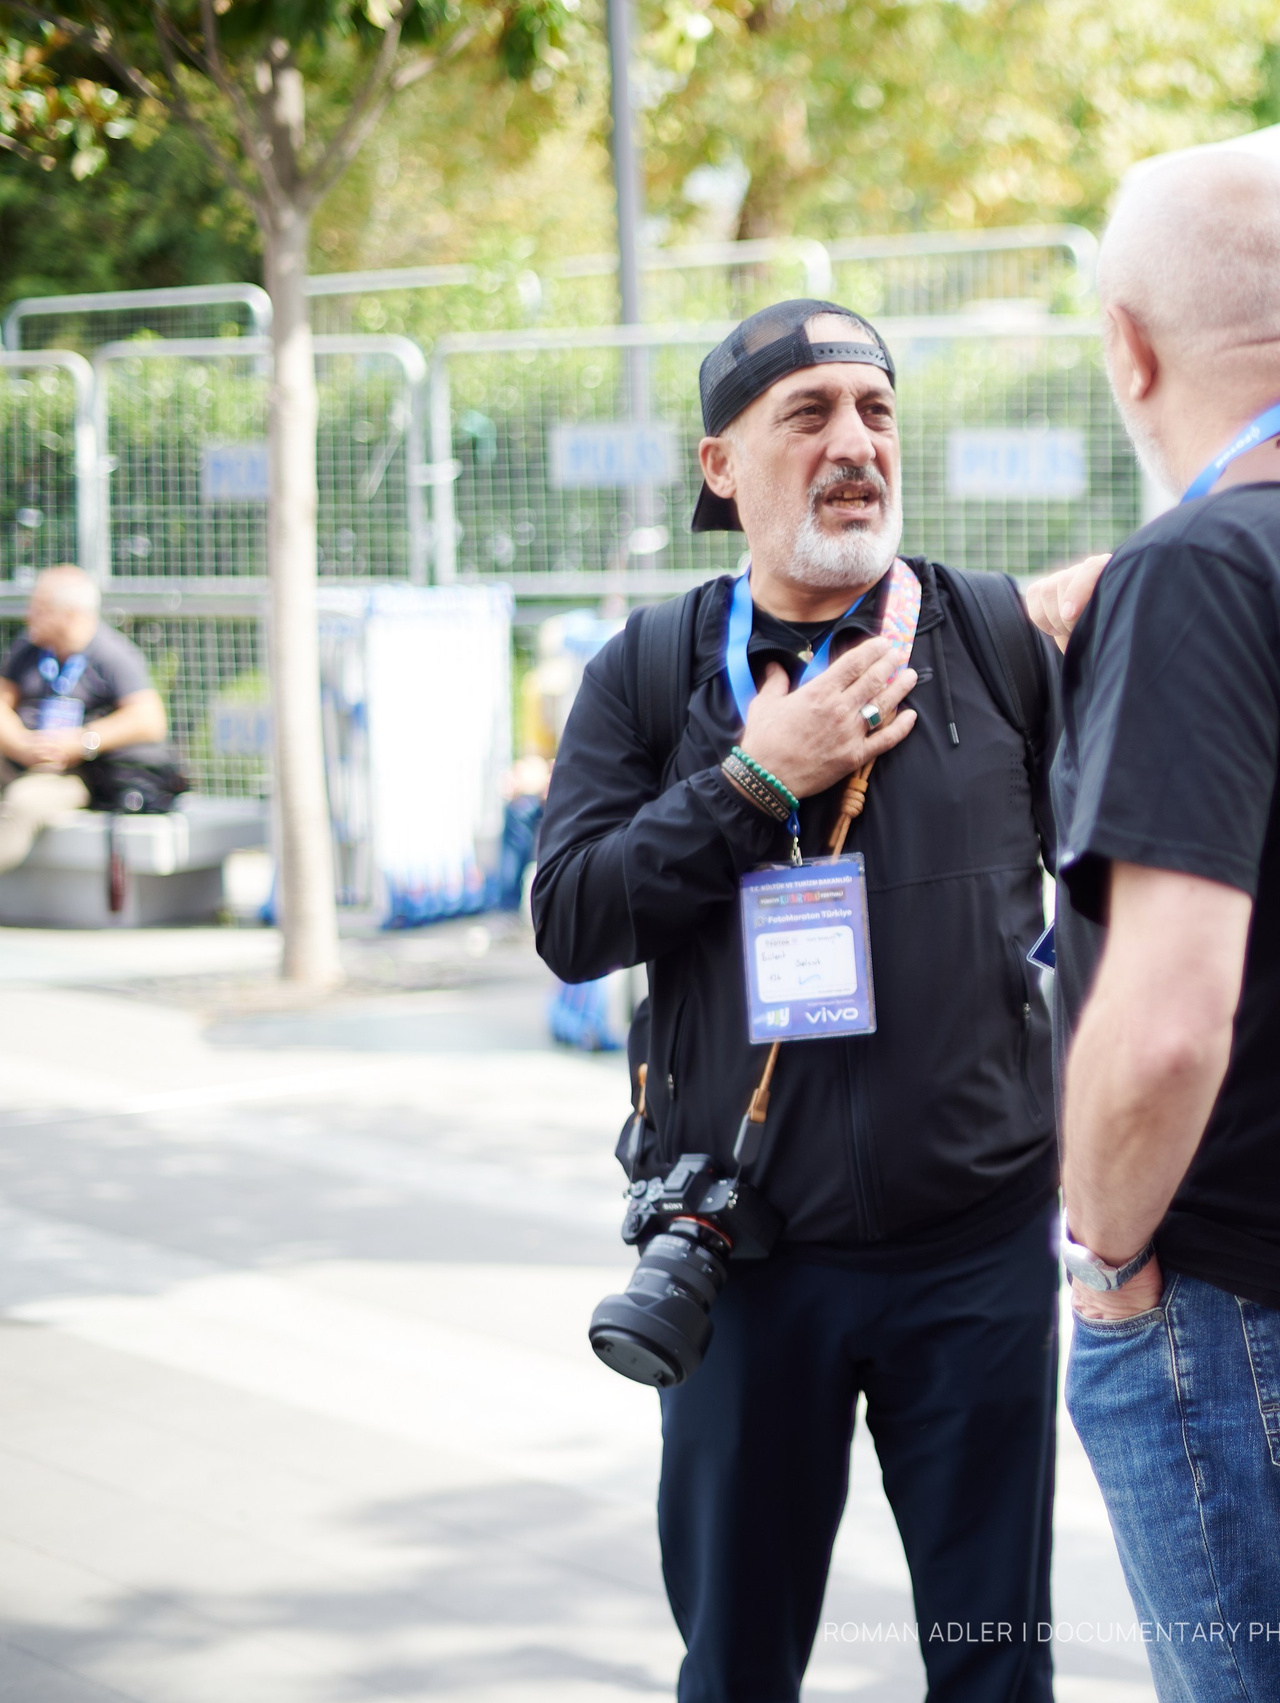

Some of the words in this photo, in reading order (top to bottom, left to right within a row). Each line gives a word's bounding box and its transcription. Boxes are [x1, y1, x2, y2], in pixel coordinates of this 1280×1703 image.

[768, 911, 820, 924] FotoMaraton
[822, 909, 853, 919] Türkiye
[805, 1006, 859, 1025] vivo
